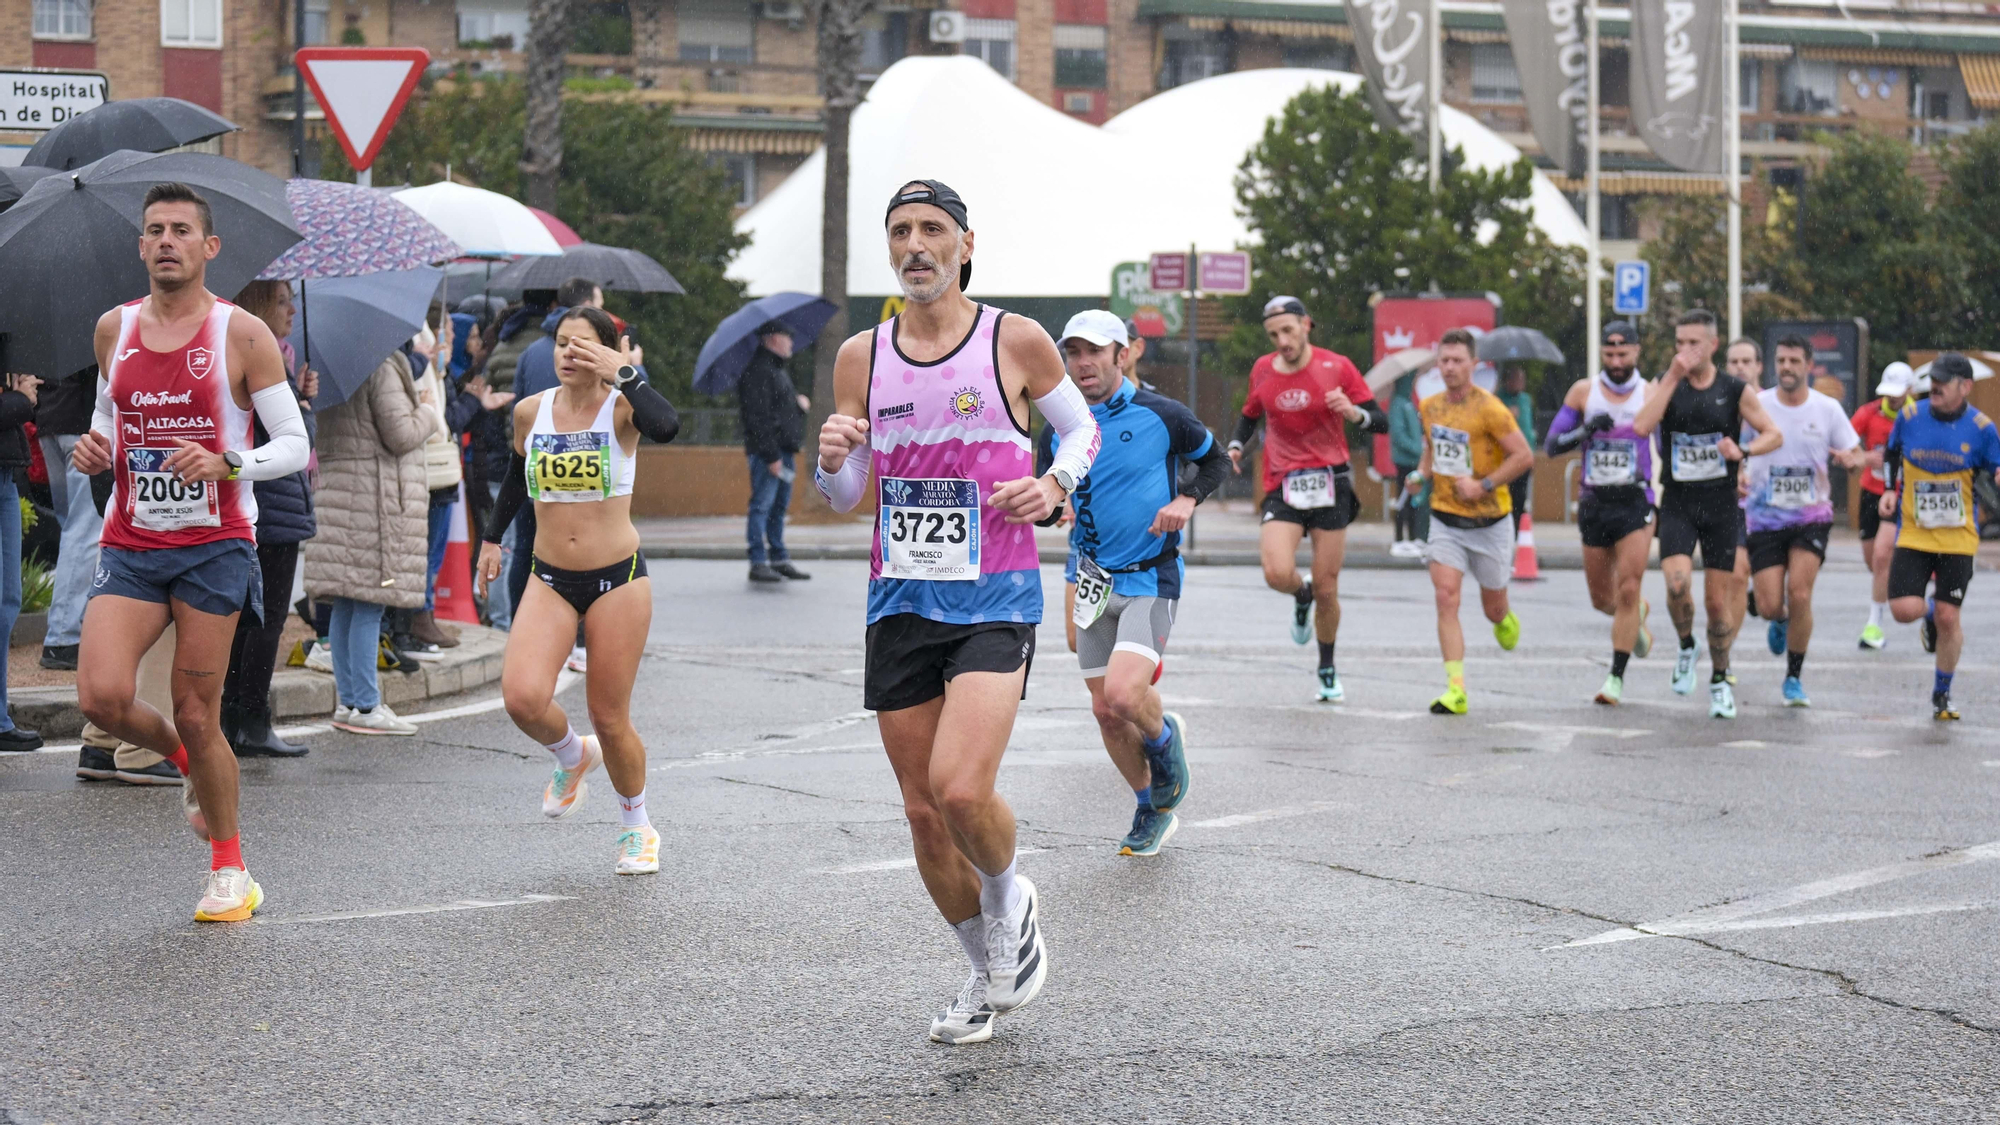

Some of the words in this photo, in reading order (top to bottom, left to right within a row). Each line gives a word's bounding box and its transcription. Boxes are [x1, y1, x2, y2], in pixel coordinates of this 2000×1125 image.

[13, 81, 95, 101] Hospital
[17, 105, 42, 121] de
[1622, 269, 1642, 294] P
[878, 403, 914, 418] IMPARABLES
[146, 417, 215, 429] ALTACASA
[538, 455, 600, 478] 1625
[1593, 453, 1629, 468] 3442
[137, 476, 204, 502] 2009
[921, 481, 956, 491] MEDIA
[1290, 475, 1326, 492] 4826
[919, 497, 960, 506] CÓRDOBA
[922, 490, 957, 499] MARATÓN
[175, 506, 193, 514] JESÚS
[1919, 495, 1959, 511] 2556
[891, 511, 966, 543] 3723
[909, 550, 942, 558] FRANCISCO
